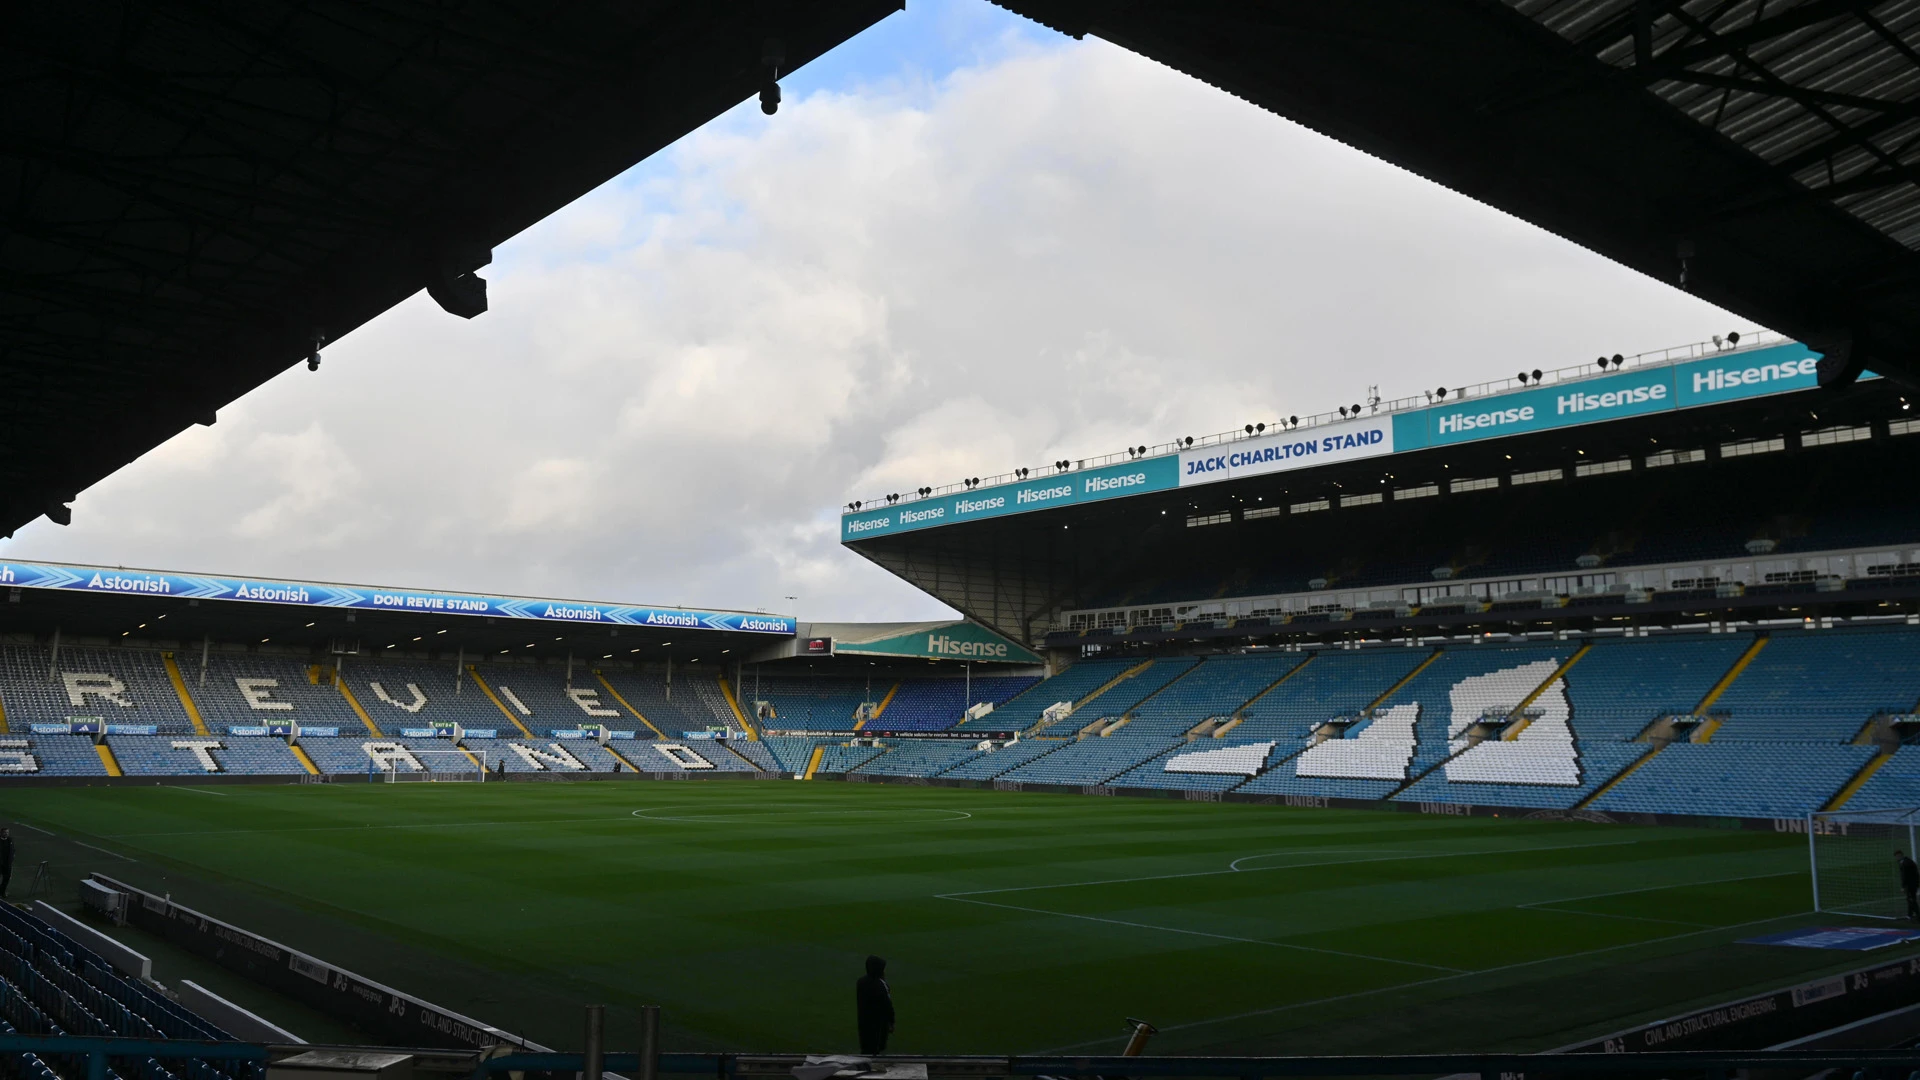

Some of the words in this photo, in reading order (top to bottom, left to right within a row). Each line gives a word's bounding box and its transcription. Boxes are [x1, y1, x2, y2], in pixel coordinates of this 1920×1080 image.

[1693, 357, 1816, 393] Hisense
[1557, 384, 1667, 415] Hisense
[1439, 405, 1534, 435] Hisense
[1187, 455, 1227, 475] JACK
[1229, 440, 1318, 468] CHARLTON
[1322, 429, 1384, 452] STAND
[1085, 471, 1145, 493] Hisense
[1017, 483, 1071, 505] Hisense
[955, 495, 1005, 515] Hisense
[900, 505, 944, 524] Hisense
[848, 516, 890, 534] Hisense
[87, 571, 170, 593] Astonish
[235, 583, 309, 602] Astonish
[373, 594, 404, 606] DON
[407, 596, 444, 609] REVIE
[447, 599, 489, 611] STAND
[544, 604, 601, 620] Astonish
[646, 611, 699, 626] Astonish
[740, 617, 788, 631] Astonish
[928, 634, 1008, 657] Hisense
[33, 725, 68, 733] Astonish
[231, 727, 266, 735] Astonish
[403, 729, 434, 737] Astonish
[993, 781, 1024, 792] UNIBET
[1082, 785, 1117, 797] UNIBET
[1184, 790, 1224, 803] UNIBET
[1285, 794, 1330, 808] UNIBET
[1420, 802, 1473, 816] UNIBET
[1774, 818, 1850, 836] UNIBET
[389, 994, 406, 1017] JPG
[421, 1009, 436, 1029] CIVIL
[437, 1015, 452, 1035] AND
[452, 1022, 497, 1048] STRUCTURAL
[1644, 1029, 1666, 1046] CIVIL
[1666, 1022, 1683, 1040] AND
[1683, 1009, 1731, 1035] STRUCTURAL
[1730, 997, 1777, 1021] ENGINEERING
